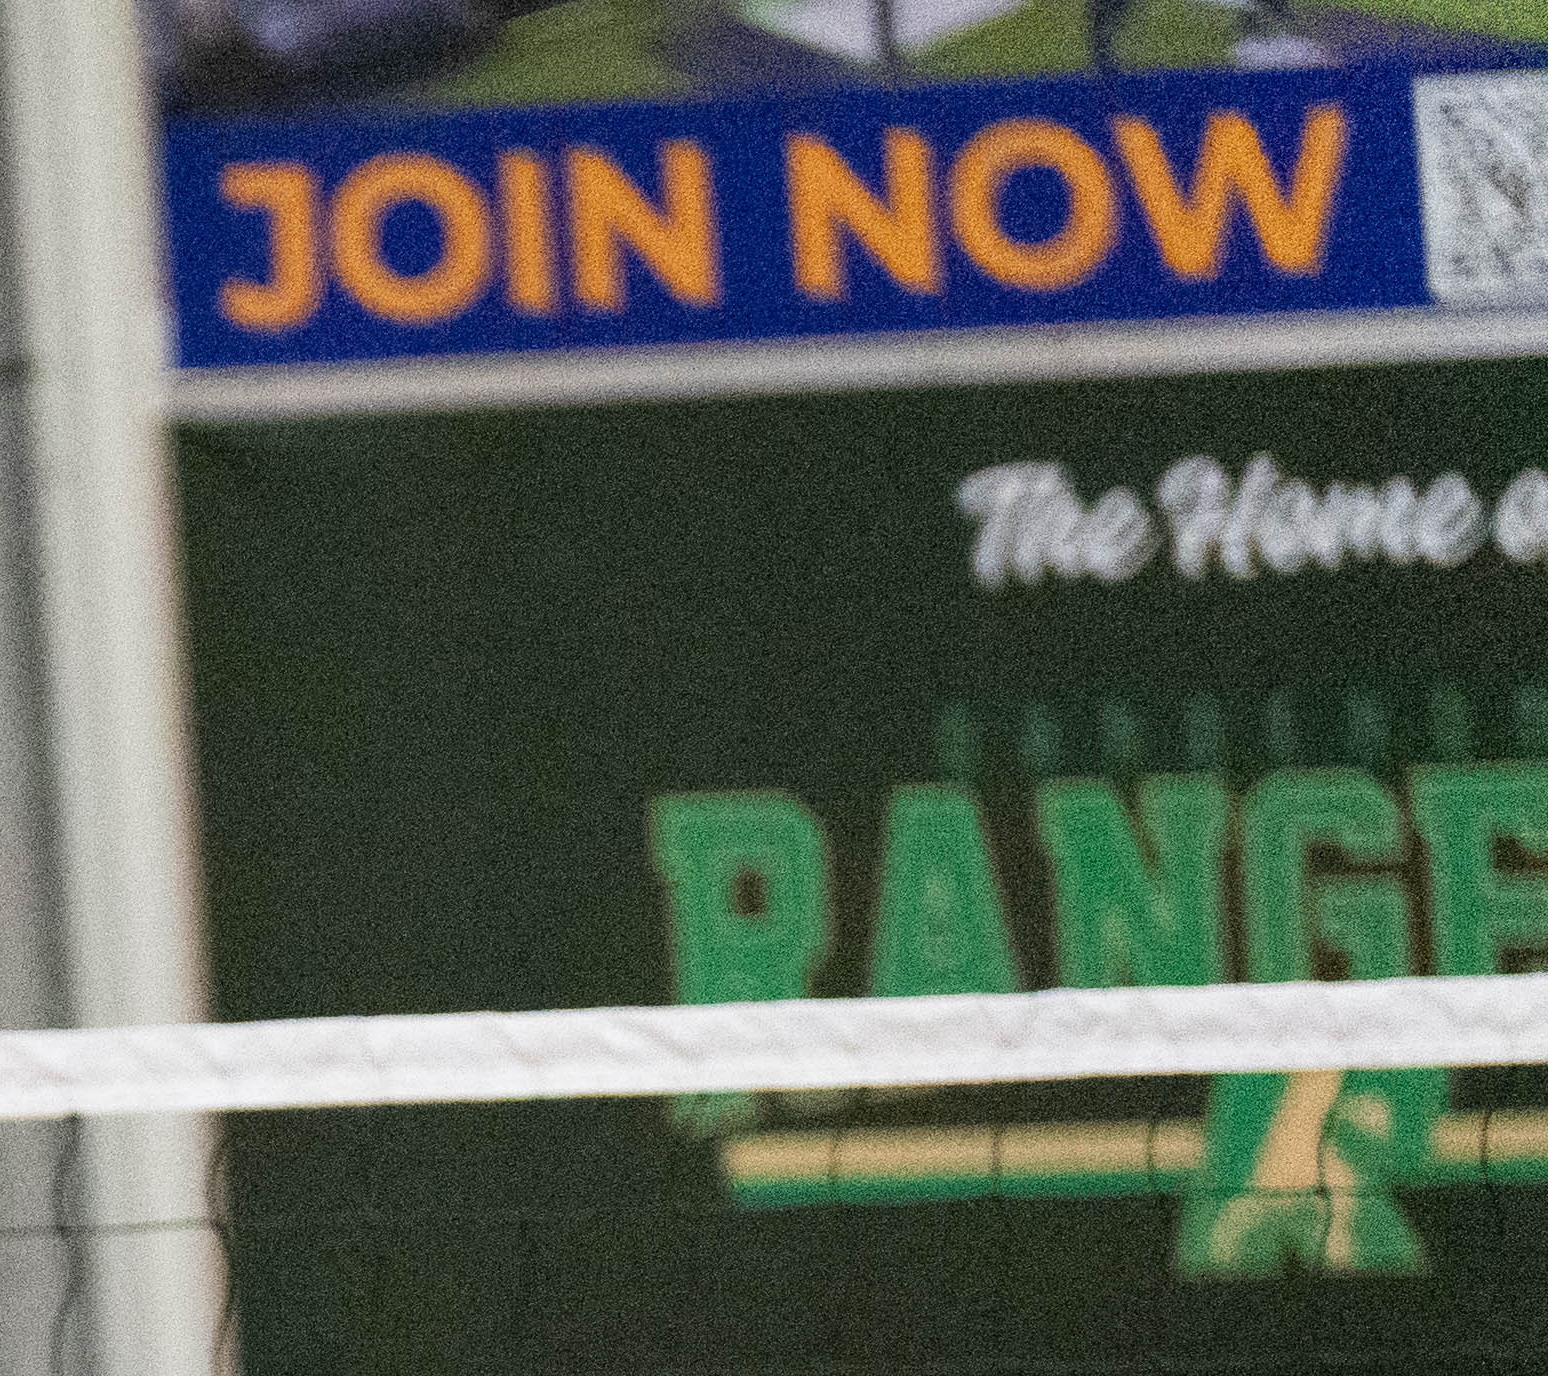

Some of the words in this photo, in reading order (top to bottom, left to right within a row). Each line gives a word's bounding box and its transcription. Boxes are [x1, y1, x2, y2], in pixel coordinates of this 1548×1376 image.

[217, 138, 722, 333] JOIN
[783, 103, 1347, 302] NOW
[958, 460, 1154, 590] The
[1158, 452, 1486, 582] Home
